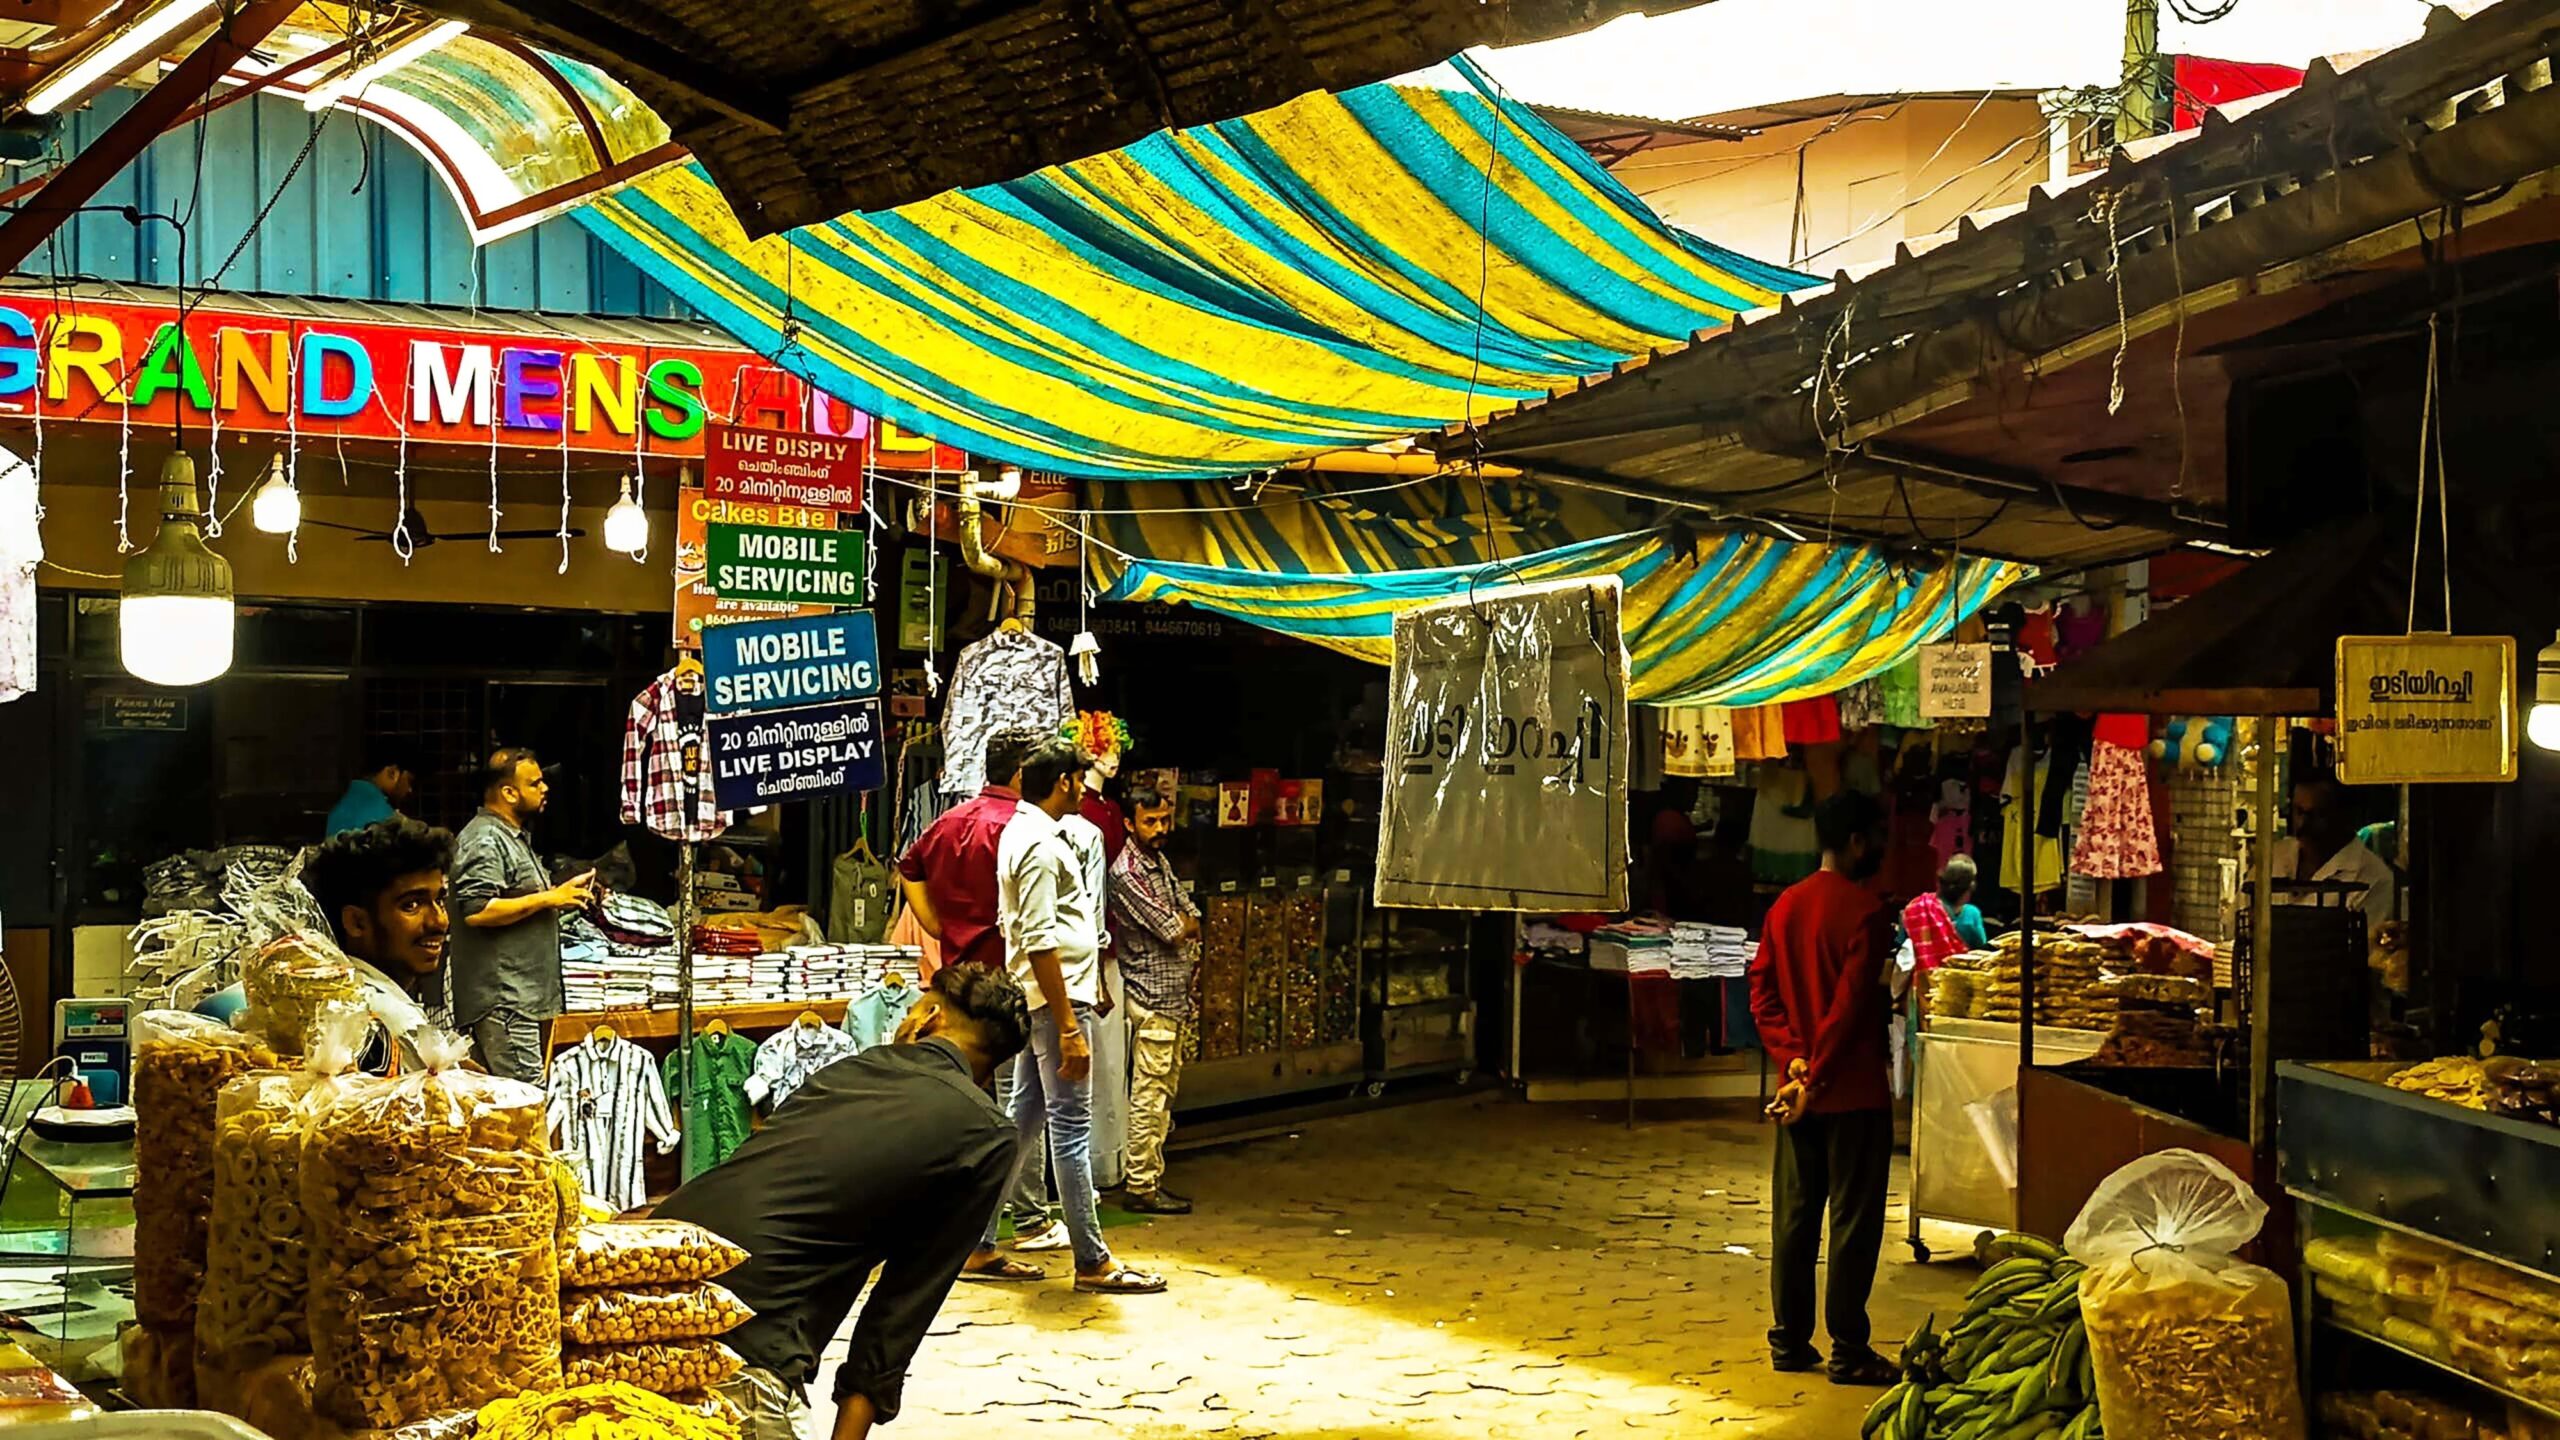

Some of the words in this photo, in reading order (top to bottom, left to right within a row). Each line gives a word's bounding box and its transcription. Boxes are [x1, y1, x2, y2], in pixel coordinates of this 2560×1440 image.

[413, 341, 704, 439] MENS
[722, 431, 769, 454] LIVE
[775, 437, 848, 462] DISPLY
[715, 476, 734, 493] 20
[691, 499, 770, 525] Cakes
[738, 533, 838, 563] MOBILE
[718, 564, 855, 596] SERVICING
[715, 600, 738, 610] are
[741, 601, 800, 613] available
[735, 627, 847, 666] MOBILE
[714, 660, 873, 705] SERVICING
[720, 731, 742, 751] 20
[720, 754, 772, 778] LIVE
[778, 740, 875, 770] DISPLAY
